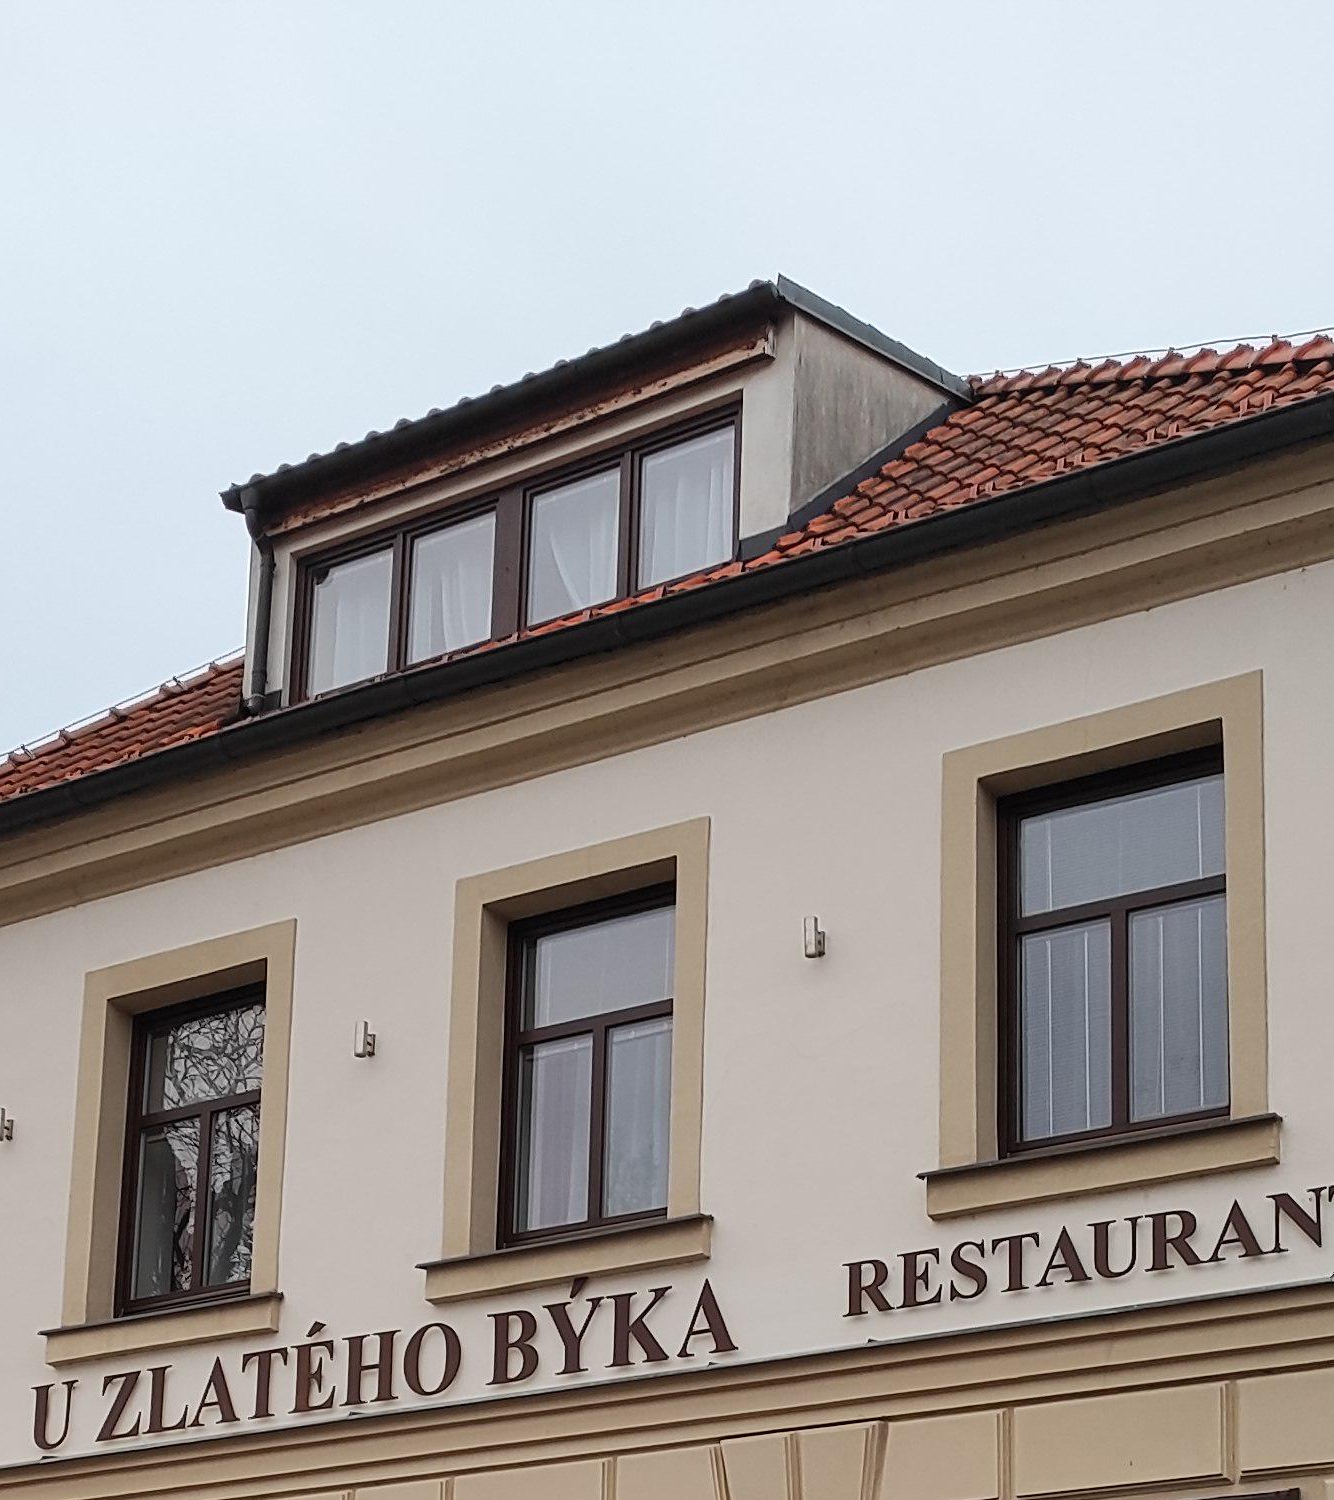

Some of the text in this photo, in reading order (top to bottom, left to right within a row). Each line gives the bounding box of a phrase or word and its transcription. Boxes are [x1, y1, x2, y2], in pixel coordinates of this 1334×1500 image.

[30, 1277, 739, 1451] U ZLATÉHO BÝKA
